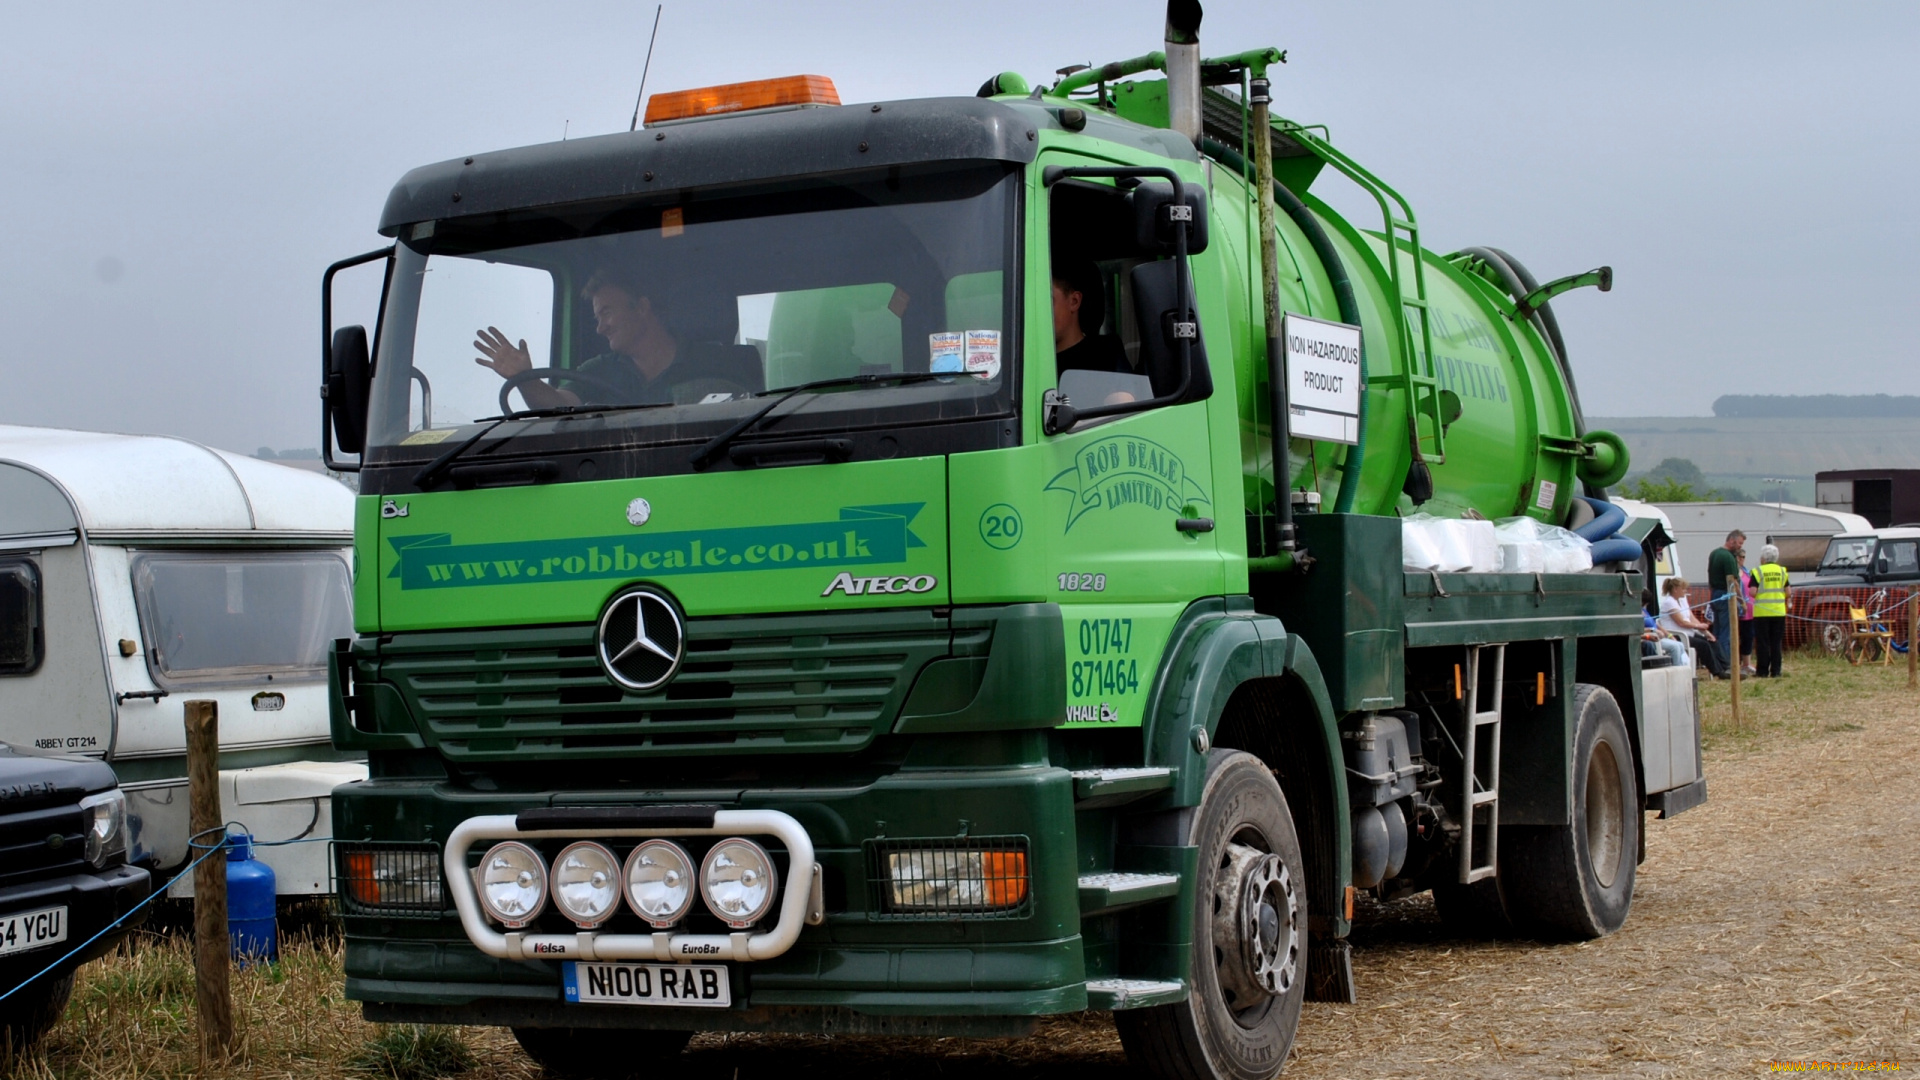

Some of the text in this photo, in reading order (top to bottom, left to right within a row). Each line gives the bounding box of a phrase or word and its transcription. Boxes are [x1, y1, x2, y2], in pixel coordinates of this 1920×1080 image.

[1289, 335, 1358, 365] NON HAZARDOUS
[1304, 370, 1343, 394] PRODUCT
[1086, 441, 1178, 485] ROB BEALE
[1106, 480, 1163, 511] LIMITED
[986, 516, 1018, 537] 20
[426, 531, 873, 582] www.robbeale.co.uk
[820, 571, 938, 597] ATEGO
[1057, 572, 1107, 592] 1828
[1079, 618, 1132, 655] 01747
[1072, 659, 1139, 698] 871464
[35, 736, 97, 749] ABBEY GT 214
[24, 910, 60, 943] YGU
[534, 942, 566, 953] Kelsa
[682, 943, 720, 954] EuroBar
[566, 986, 577, 995] GB
[660, 968, 719, 1000] RAB
